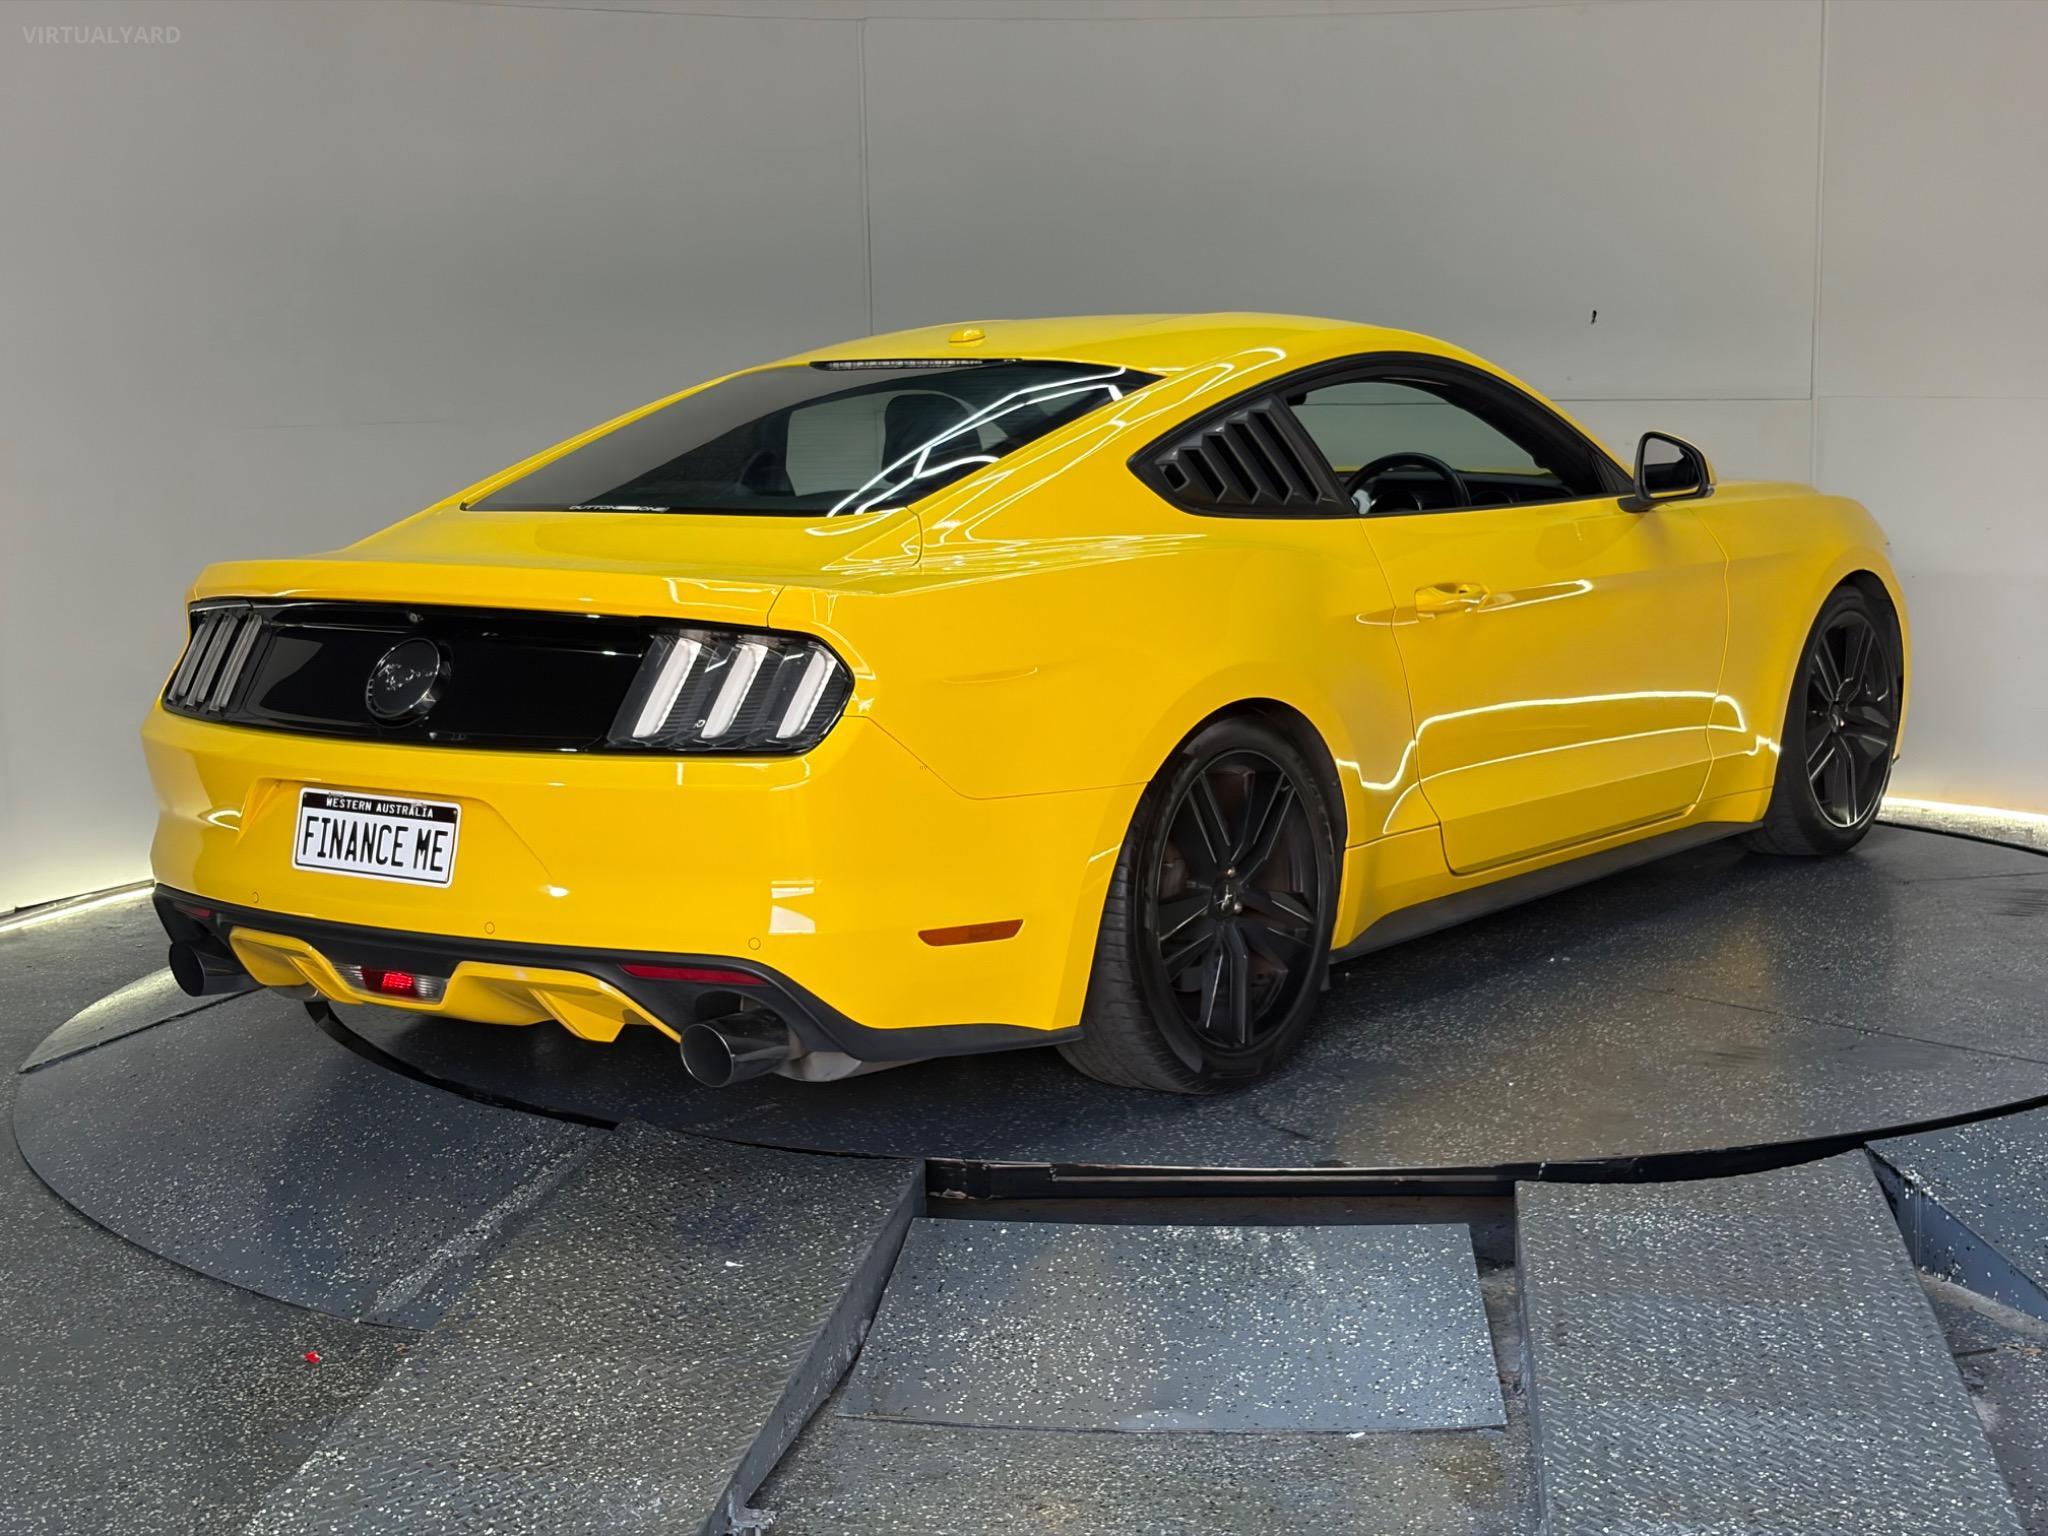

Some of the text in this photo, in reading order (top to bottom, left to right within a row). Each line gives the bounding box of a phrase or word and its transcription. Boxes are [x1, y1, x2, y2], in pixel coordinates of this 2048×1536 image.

[326, 797, 434, 819] WESTERN AUSTRALIA
[302, 815, 449, 872] FINANCE ME
